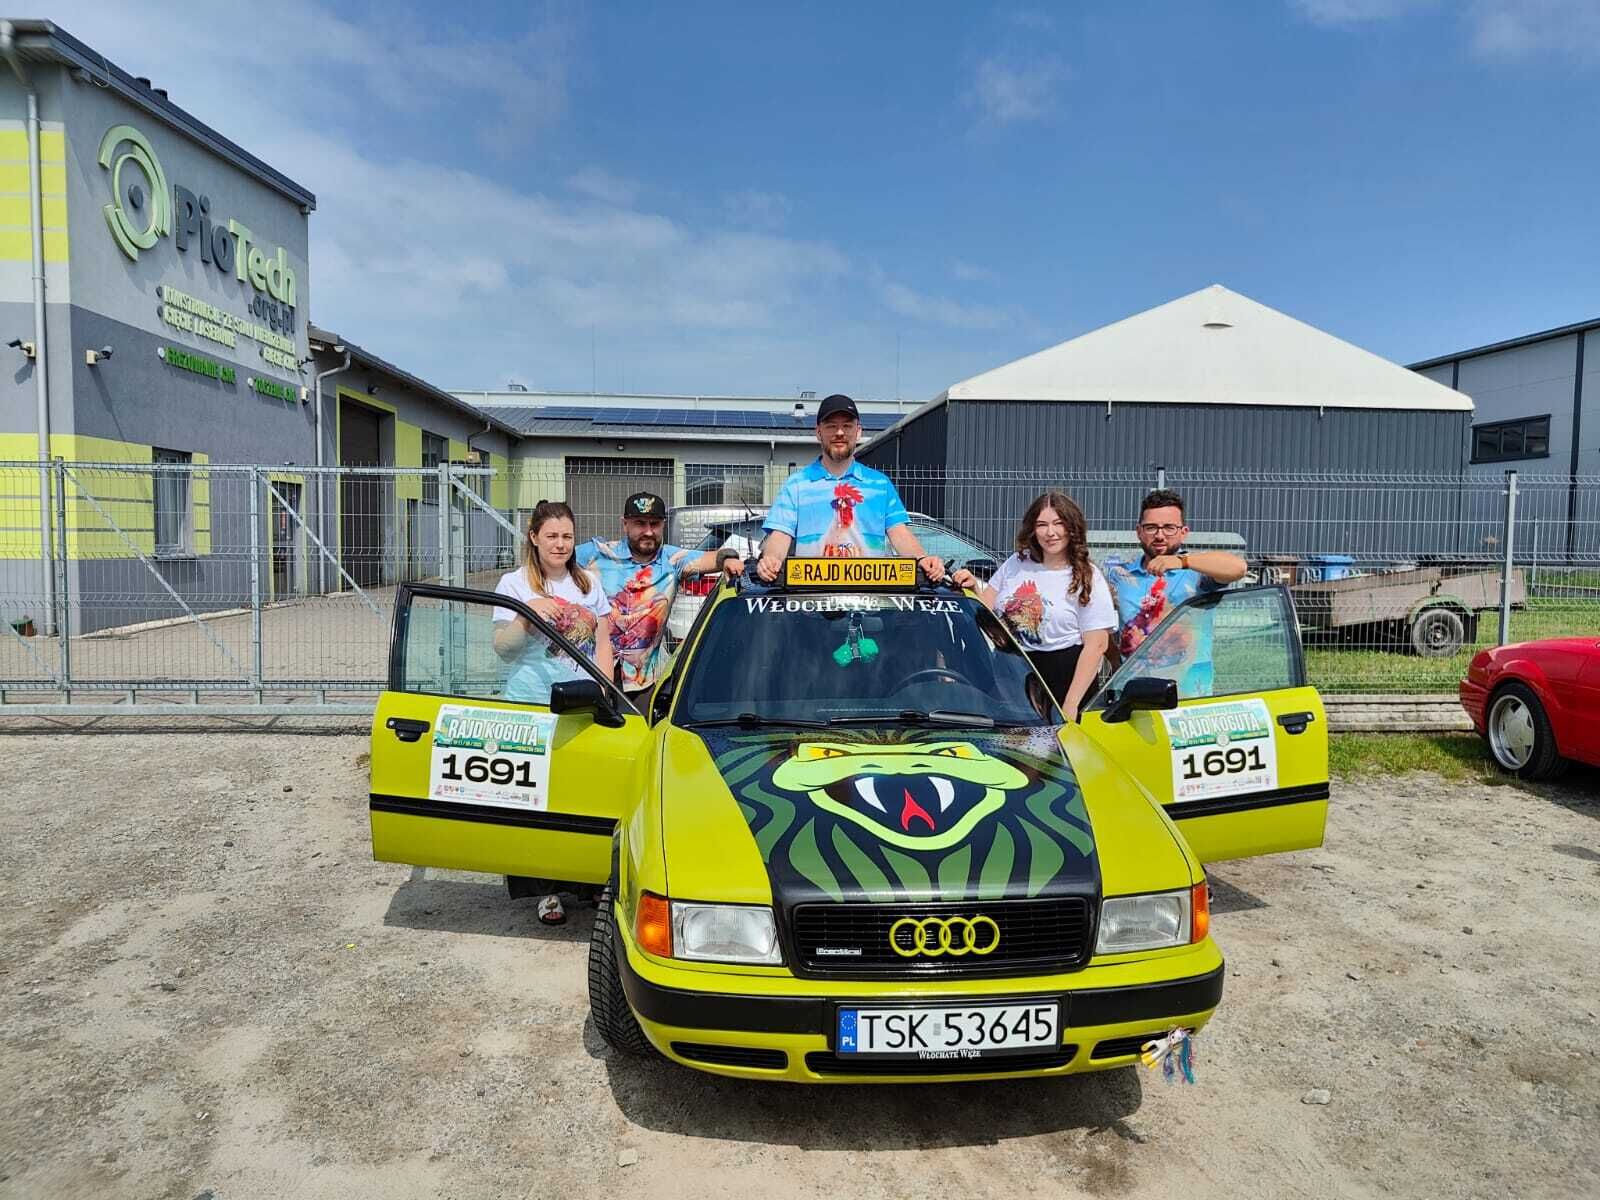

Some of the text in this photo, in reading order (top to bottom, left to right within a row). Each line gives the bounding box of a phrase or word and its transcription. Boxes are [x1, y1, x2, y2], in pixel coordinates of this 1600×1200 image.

[174, 184, 296, 309] PioTech
[247, 294, 296, 337] .org.pl
[804, 563, 840, 582] RAJD
[844, 563, 898, 582] KOGUTA
[888, 596, 964, 615] WĘŻE
[448, 718, 539, 746] RAJD KOGUTA
[1178, 716, 1210, 740] RAJD
[1210, 711, 1260, 735] KOGUTA
[441, 753, 537, 788] 1691
[1182, 745, 1266, 780] 1691
[842, 1007, 1052, 1049] PL TSK 53645
